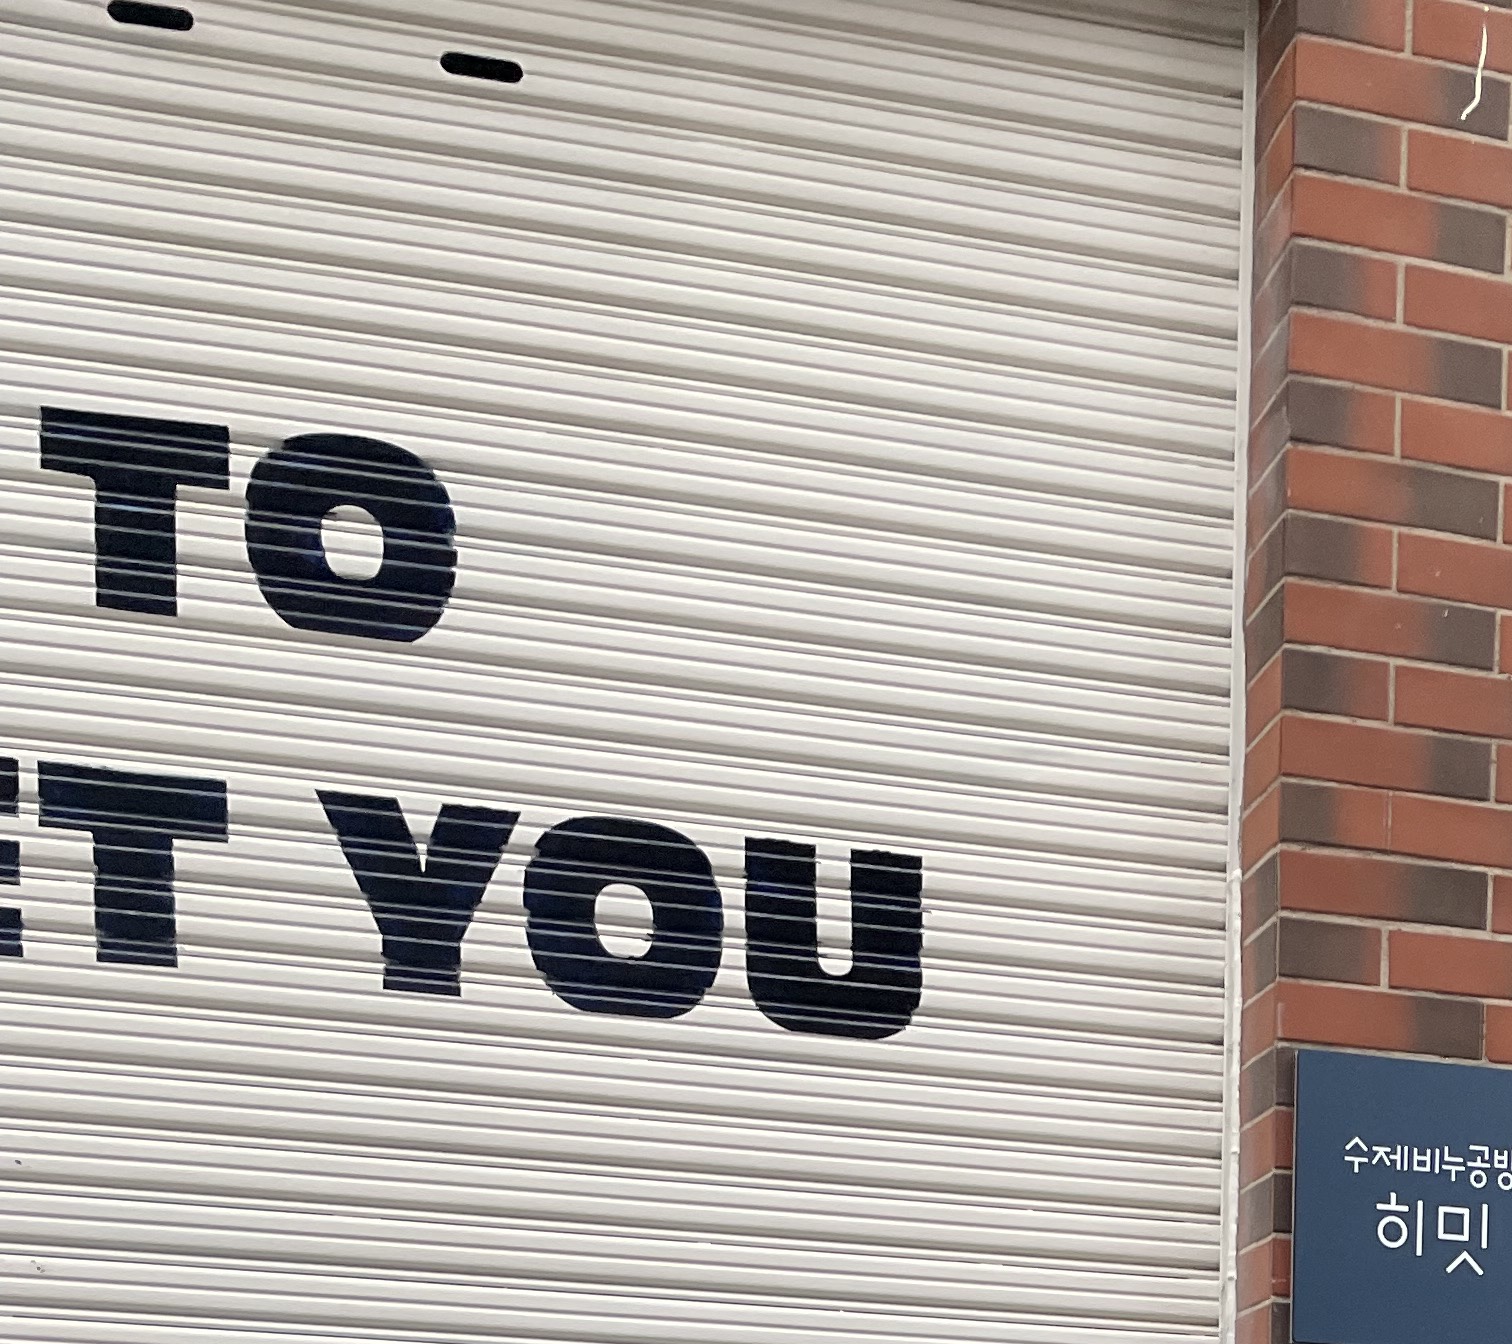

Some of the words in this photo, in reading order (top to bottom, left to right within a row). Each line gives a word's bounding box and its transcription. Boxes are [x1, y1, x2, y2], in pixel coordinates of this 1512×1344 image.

[40, 406, 458, 644] TO
[0, 756, 229, 968] T
[315, 789, 923, 1041] YOU
[1376, 1192, 1489, 1276] 히밋
